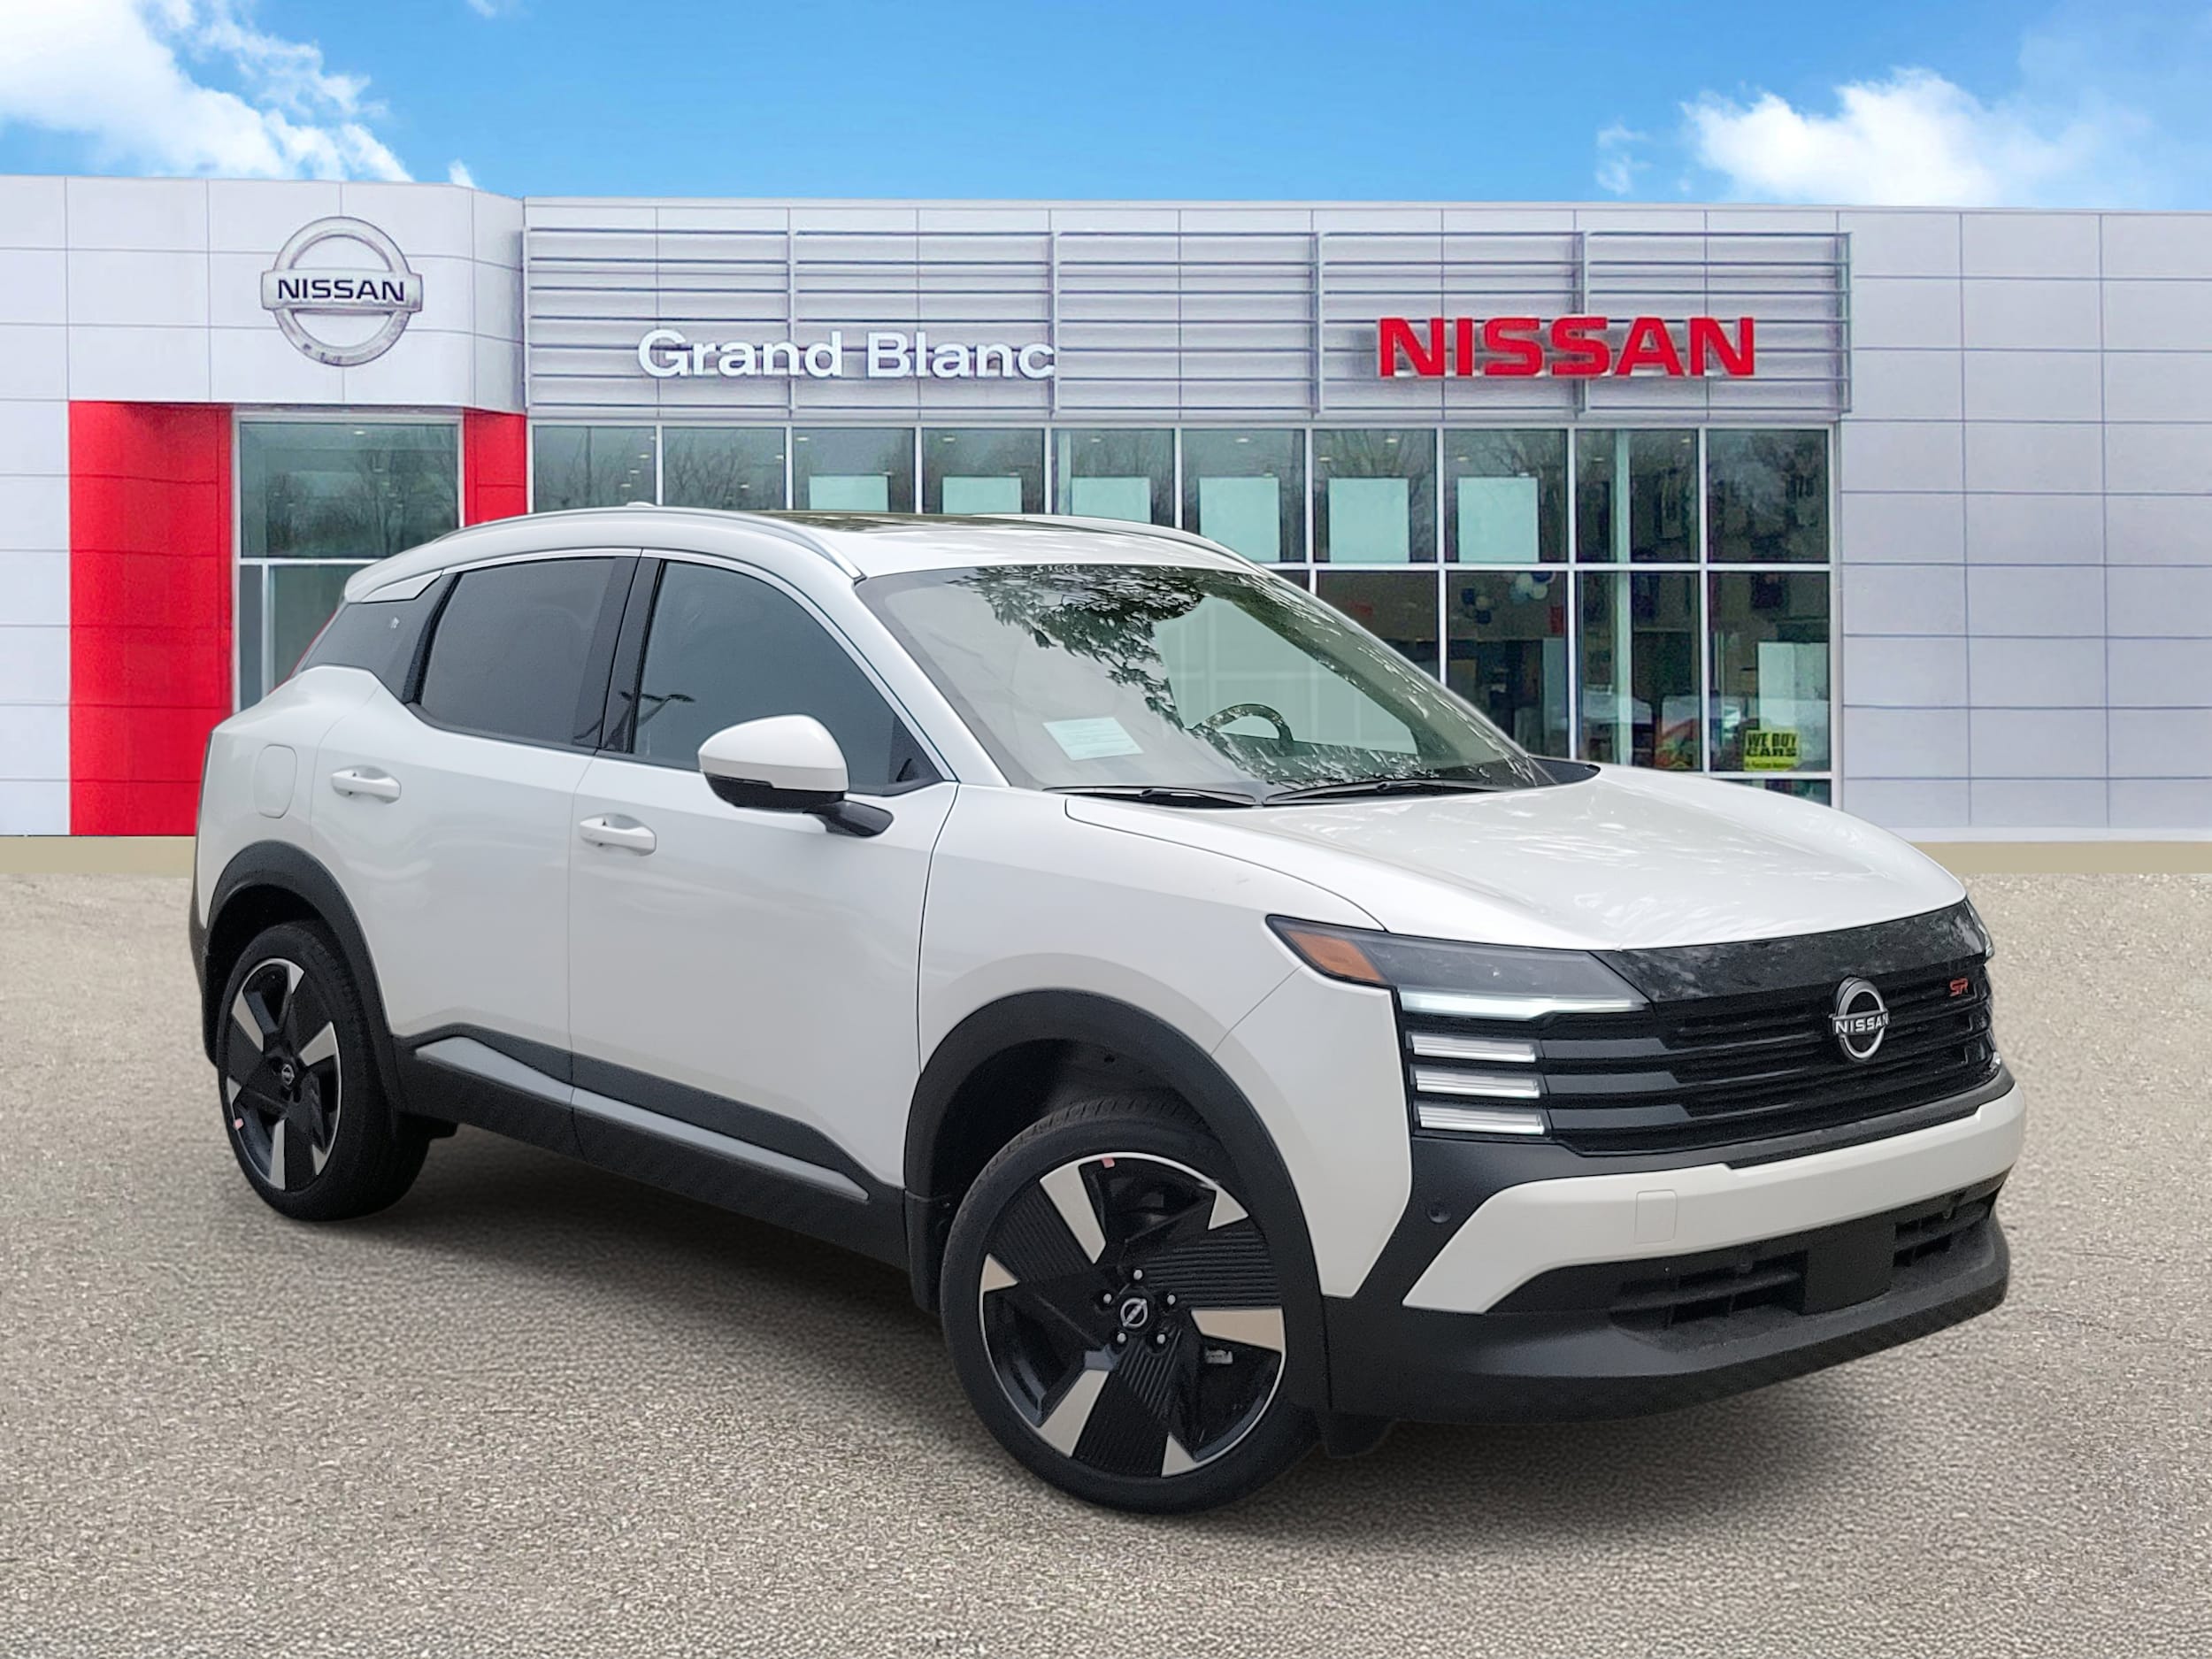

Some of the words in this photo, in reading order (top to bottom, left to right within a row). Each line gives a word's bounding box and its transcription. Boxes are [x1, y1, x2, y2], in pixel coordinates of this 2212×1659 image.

[278, 278, 405, 302] NISSAN
[637, 328, 841, 379] Grand
[866, 331, 1056, 380] Blanc
[1378, 316, 1755, 378] NISSAN
[1746, 747, 1797, 757] CARS
[1747, 733, 1769, 748] WE
[1771, 733, 1797, 748] BUY
[1835, 1010, 1890, 1034] NISSAN
